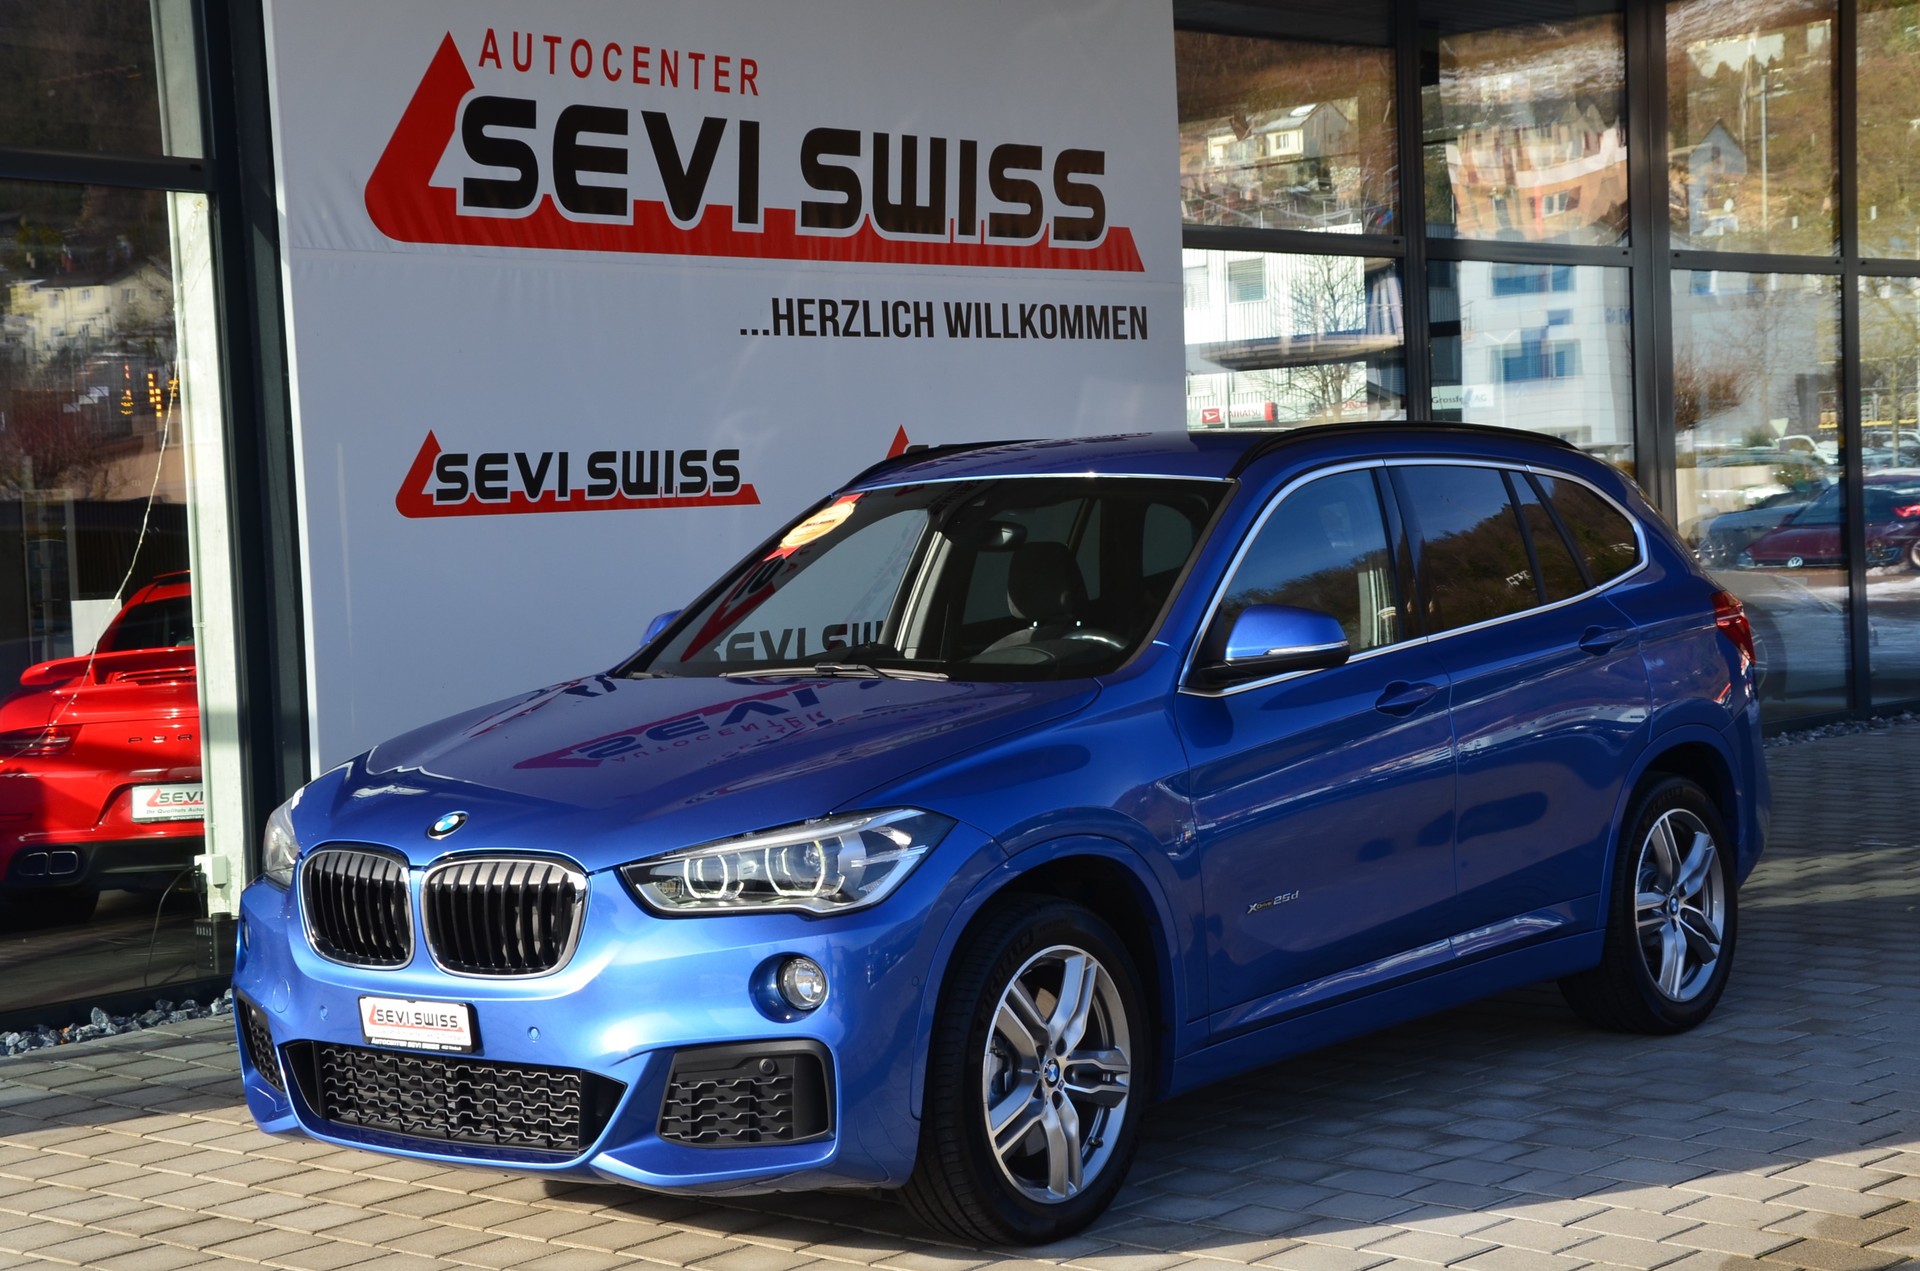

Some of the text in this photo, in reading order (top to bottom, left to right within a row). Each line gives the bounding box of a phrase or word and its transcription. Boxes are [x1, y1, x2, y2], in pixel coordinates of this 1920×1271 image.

[479, 28, 760, 96] AUTOCENTER
[461, 95, 1106, 242] SEVI SWISS
[740, 297, 1149, 341] ...HERZLICH WILLKOMMEN
[435, 449, 741, 502] SEVI SWISS
[159, 791, 204, 804] SEVI
[376, 1009, 458, 1028] SEVI SWISS
